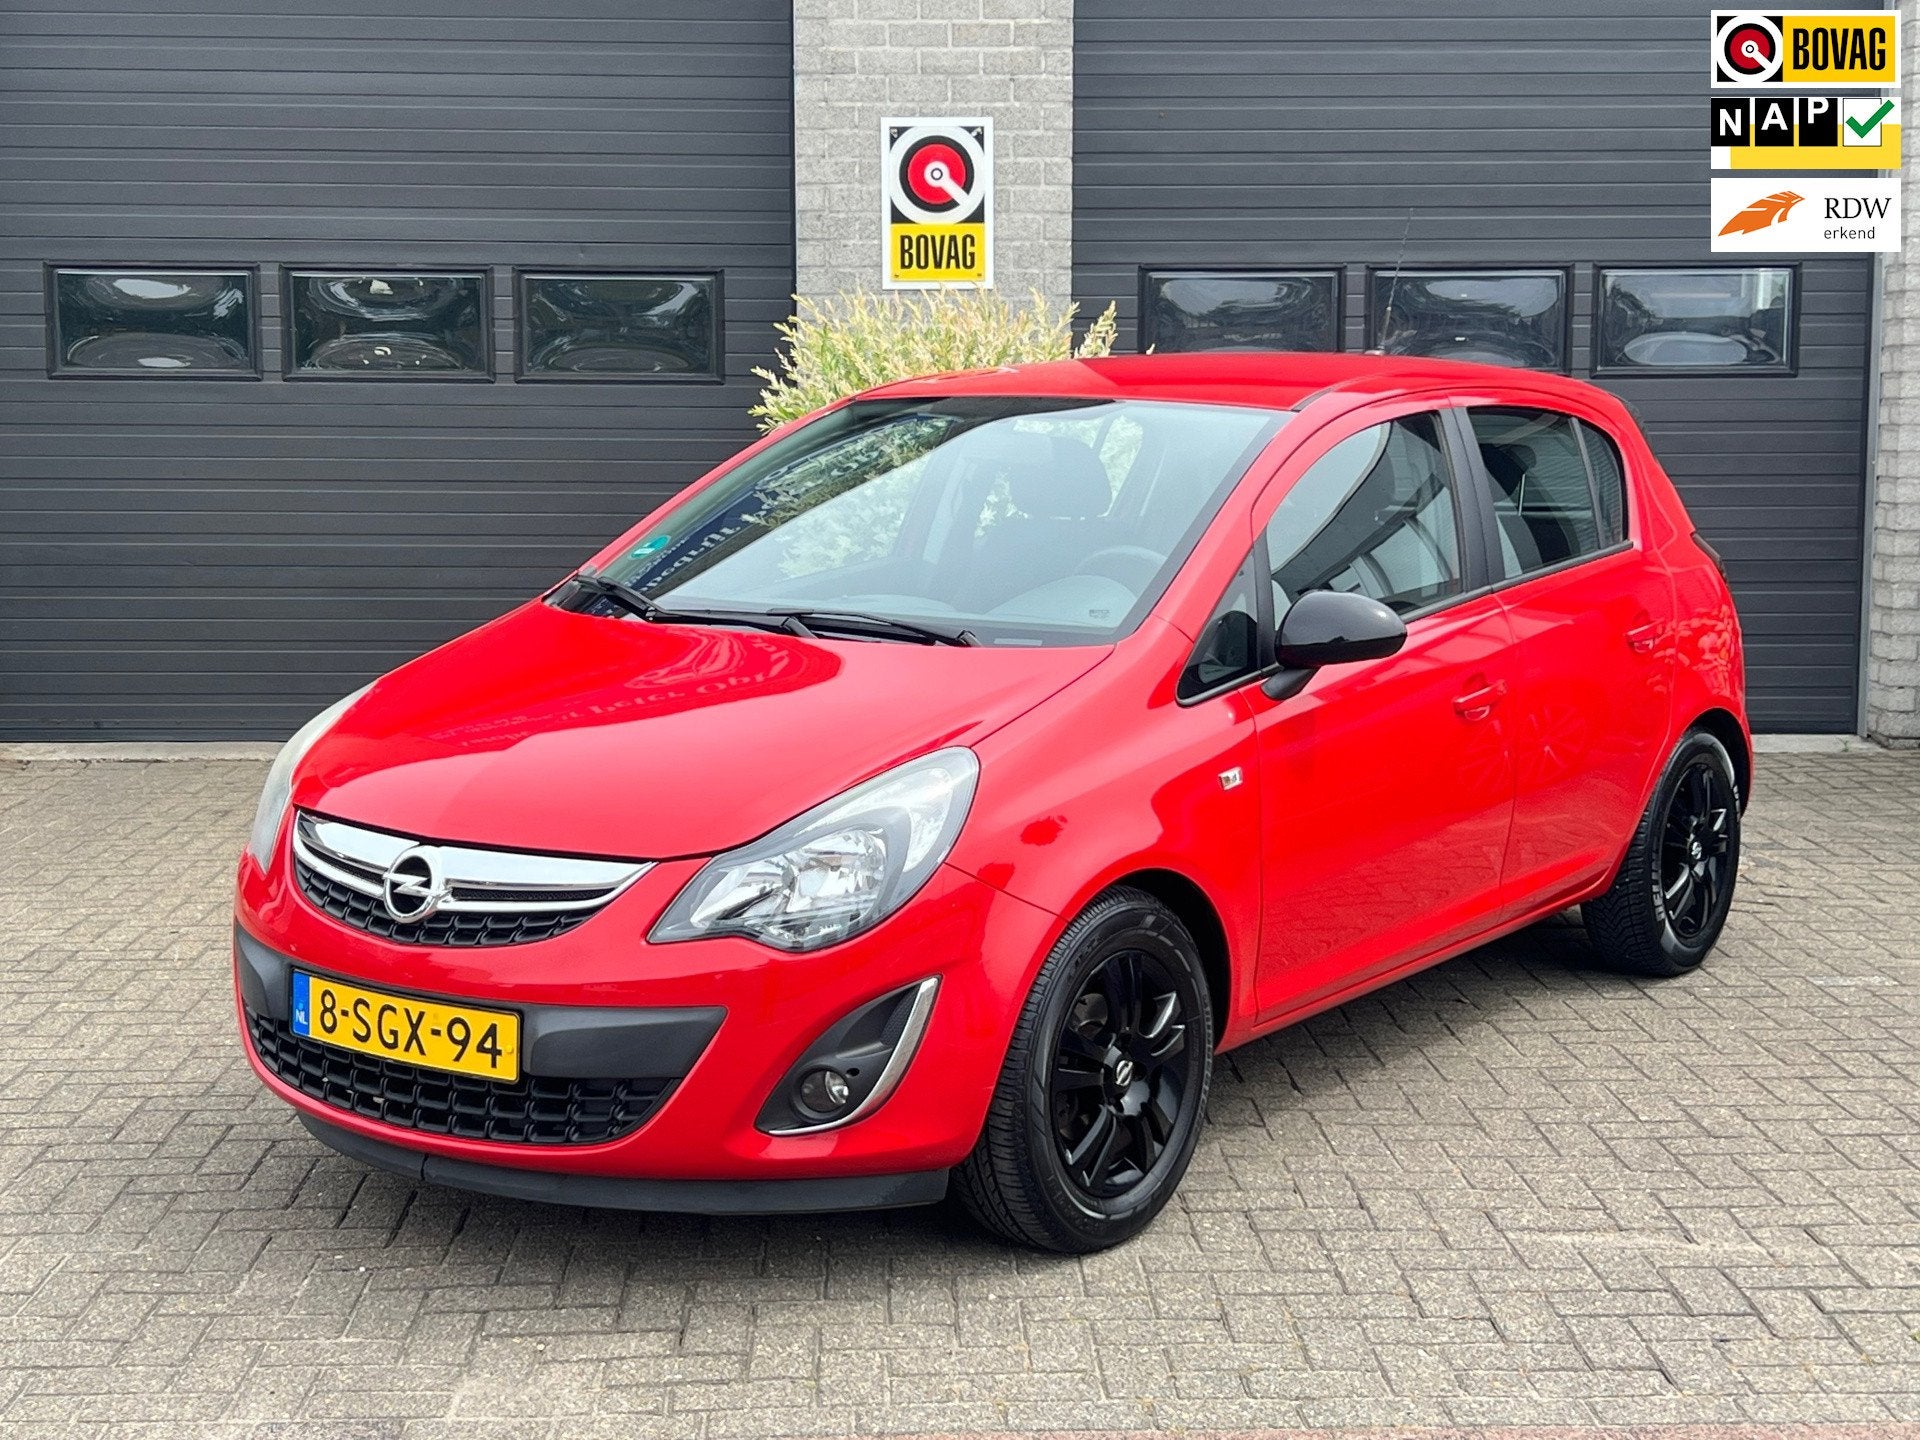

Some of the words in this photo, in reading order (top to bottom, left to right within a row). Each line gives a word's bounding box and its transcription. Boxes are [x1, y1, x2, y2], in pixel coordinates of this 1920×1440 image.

[900, 233, 976, 270] BOVAG
[295, 1009, 309, 1026] NL
[320, 989, 503, 1069] 8-SGX-94
